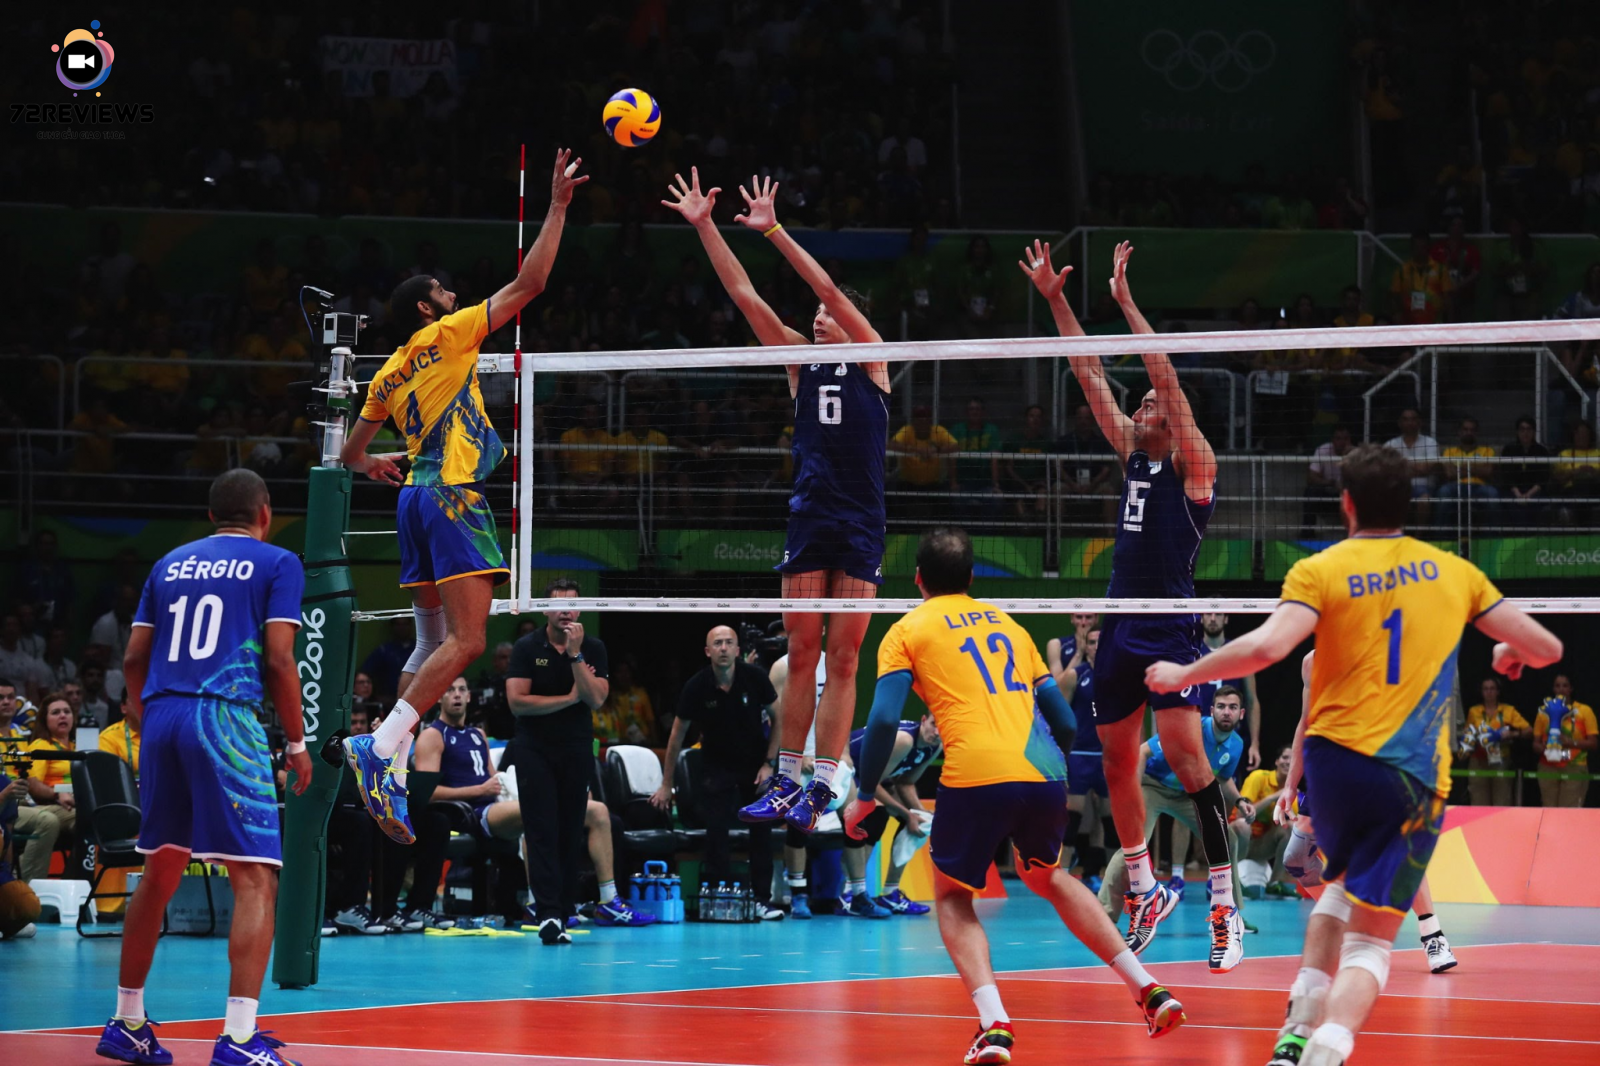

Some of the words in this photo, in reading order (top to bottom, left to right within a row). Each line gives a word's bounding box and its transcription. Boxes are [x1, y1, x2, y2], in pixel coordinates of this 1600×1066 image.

[375, 345, 442, 403] WALLACE
[405, 390, 425, 439] 4
[818, 385, 842, 425] 6
[164, 555, 254, 582] SÉRGIO
[1347, 560, 1438, 598] BRUNO
[168, 594, 224, 662] 10
[944, 611, 1002, 629] LIPE
[959, 632, 1028, 694] 12
[1382, 608, 1401, 684] 1
[469, 749, 486, 777] 11
